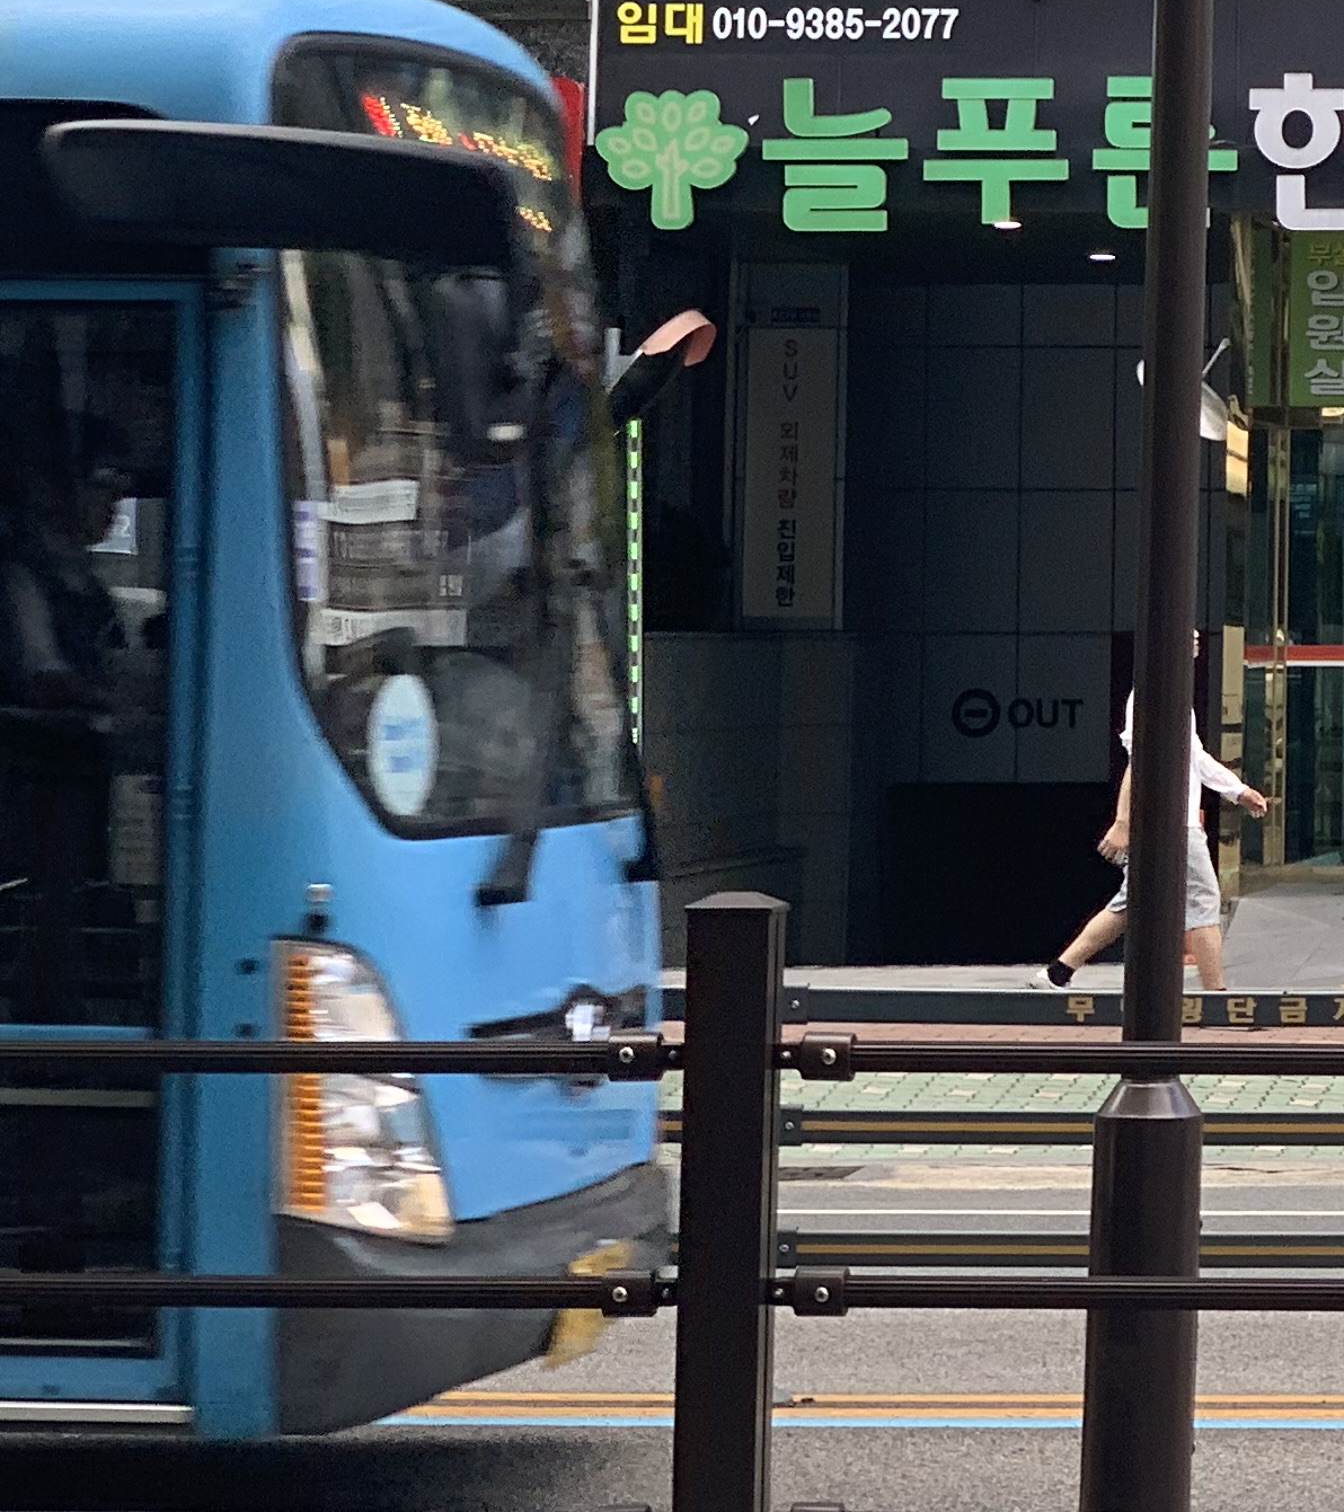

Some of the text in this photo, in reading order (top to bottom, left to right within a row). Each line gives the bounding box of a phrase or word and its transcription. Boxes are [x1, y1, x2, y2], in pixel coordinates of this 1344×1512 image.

[616, 1, 959, 44] 임대 010-9385-2077
[783, 340, 799, 400] SUV
[776, 422, 800, 510] 외제차량
[1008, 698, 1084, 729] OUT
